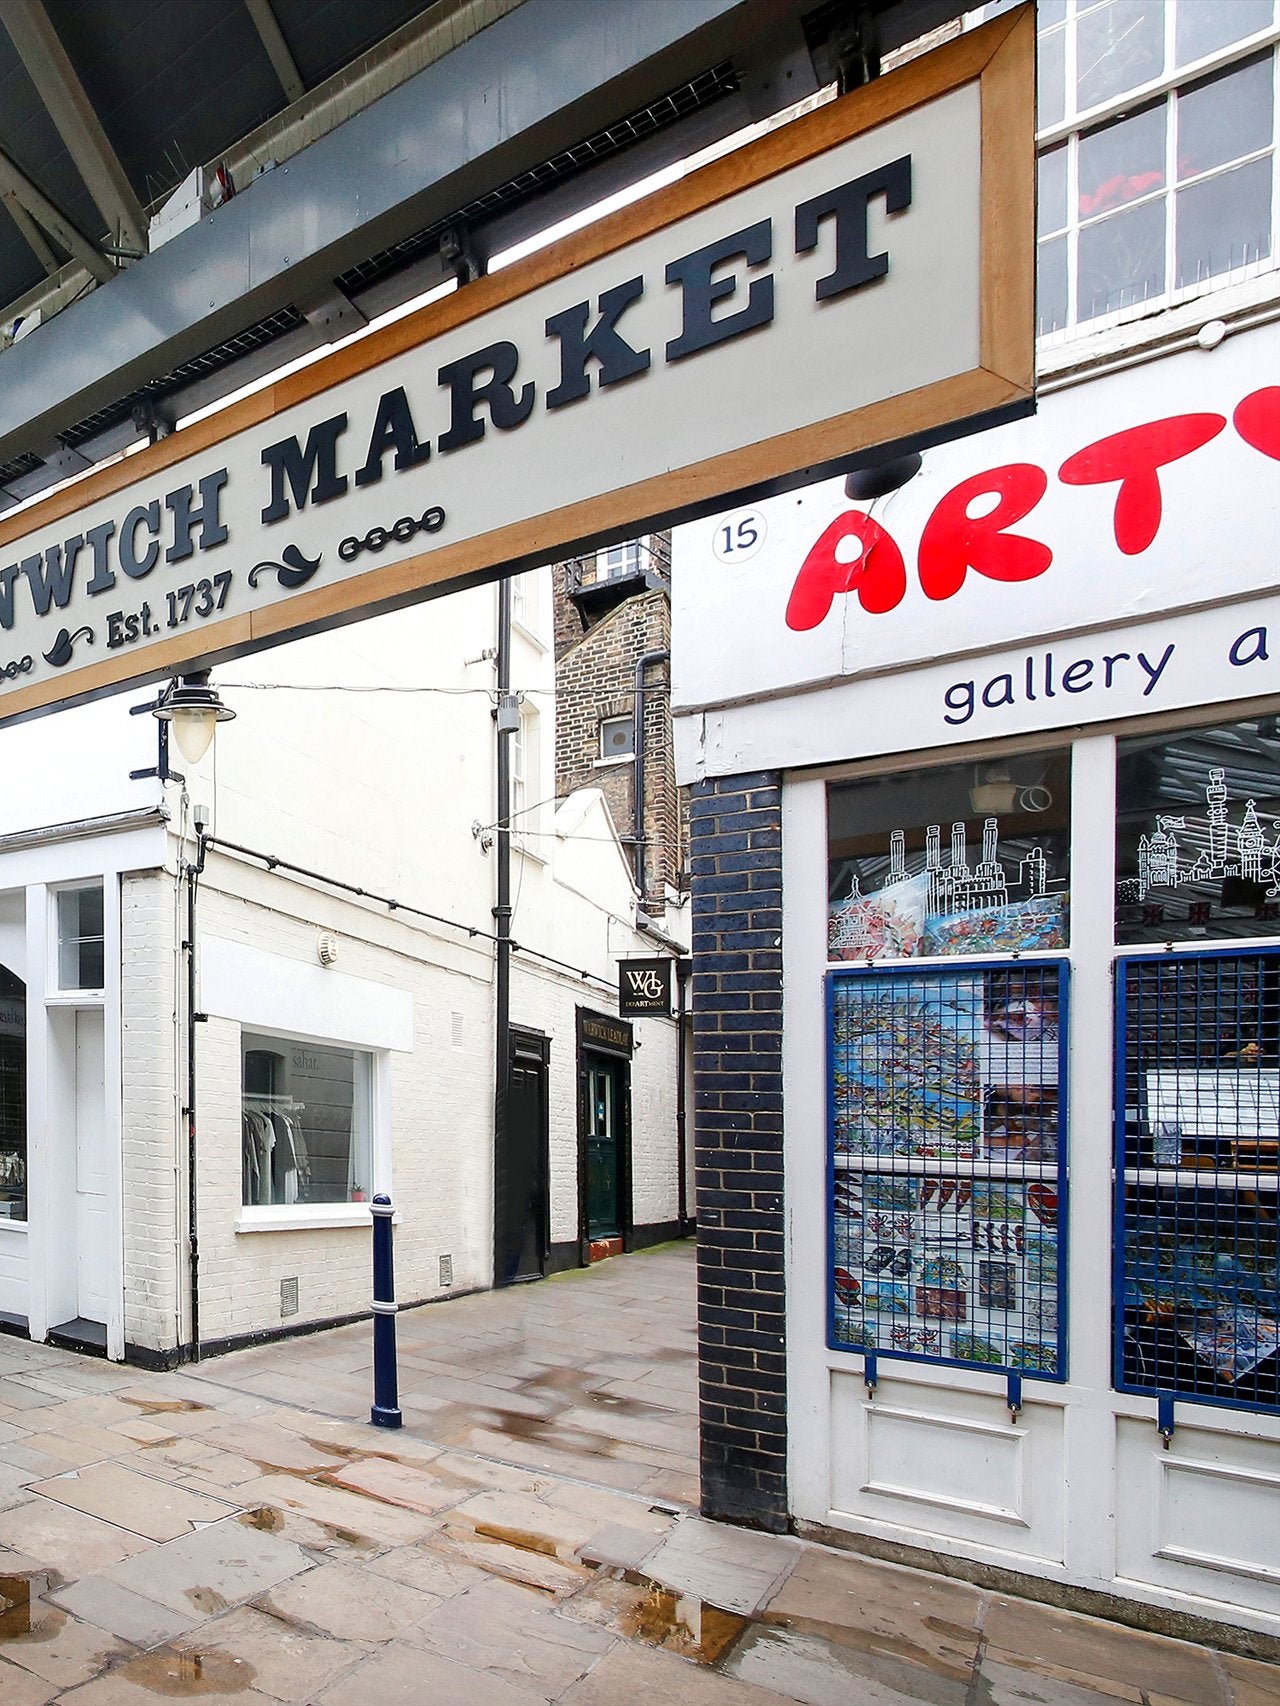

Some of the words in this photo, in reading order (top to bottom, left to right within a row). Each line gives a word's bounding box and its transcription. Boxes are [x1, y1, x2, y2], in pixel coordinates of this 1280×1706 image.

[261, 153, 912, 524] MARKET
[721, 517, 758, 554] 15
[107, 601, 160, 648] Est.
[166, 569, 233, 628] 1737
[943, 643, 1175, 726] gallery
[1228, 626, 1269, 666] a
